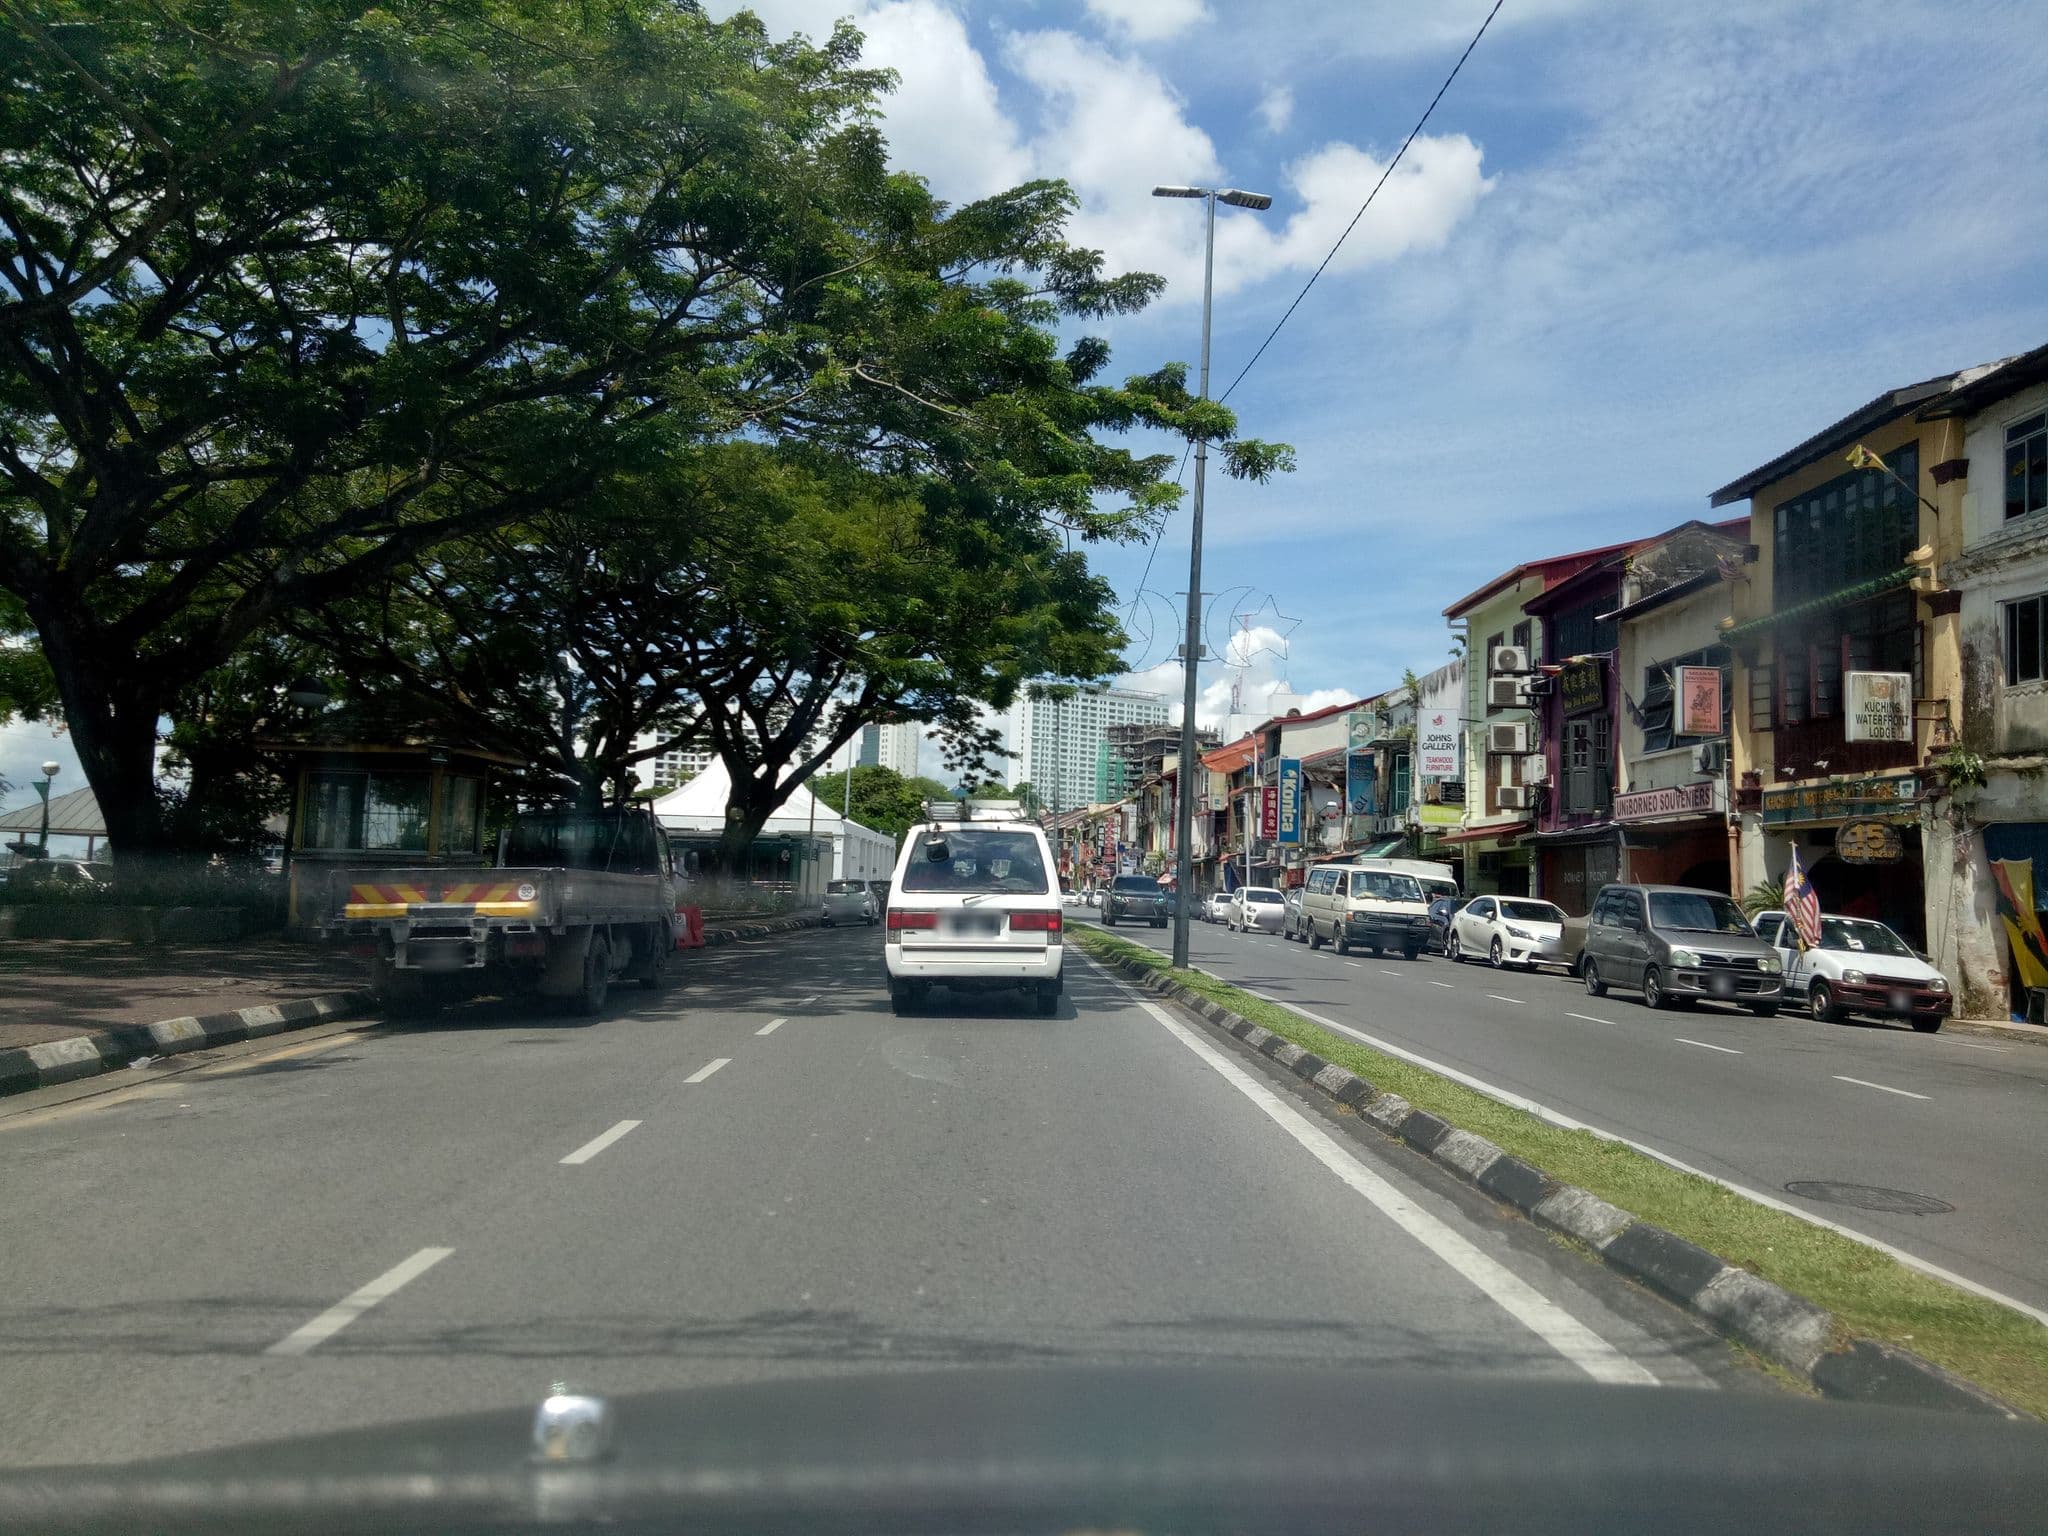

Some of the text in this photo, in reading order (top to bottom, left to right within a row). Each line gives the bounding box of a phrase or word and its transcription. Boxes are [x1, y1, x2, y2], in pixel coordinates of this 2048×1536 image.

[1864, 701, 1900, 713] KUCHING
[1856, 714, 1909, 726] WATERFRONT
[1427, 734, 1452, 742] JOHNS
[1869, 727, 1896, 738] LODGE
[1660, 787, 1710, 810] SOUVENIERS
[1281, 778, 1297, 832] Konica
[1850, 824, 1886, 849] 15
[1843, 848, 1896, 858] Main Bazaar
